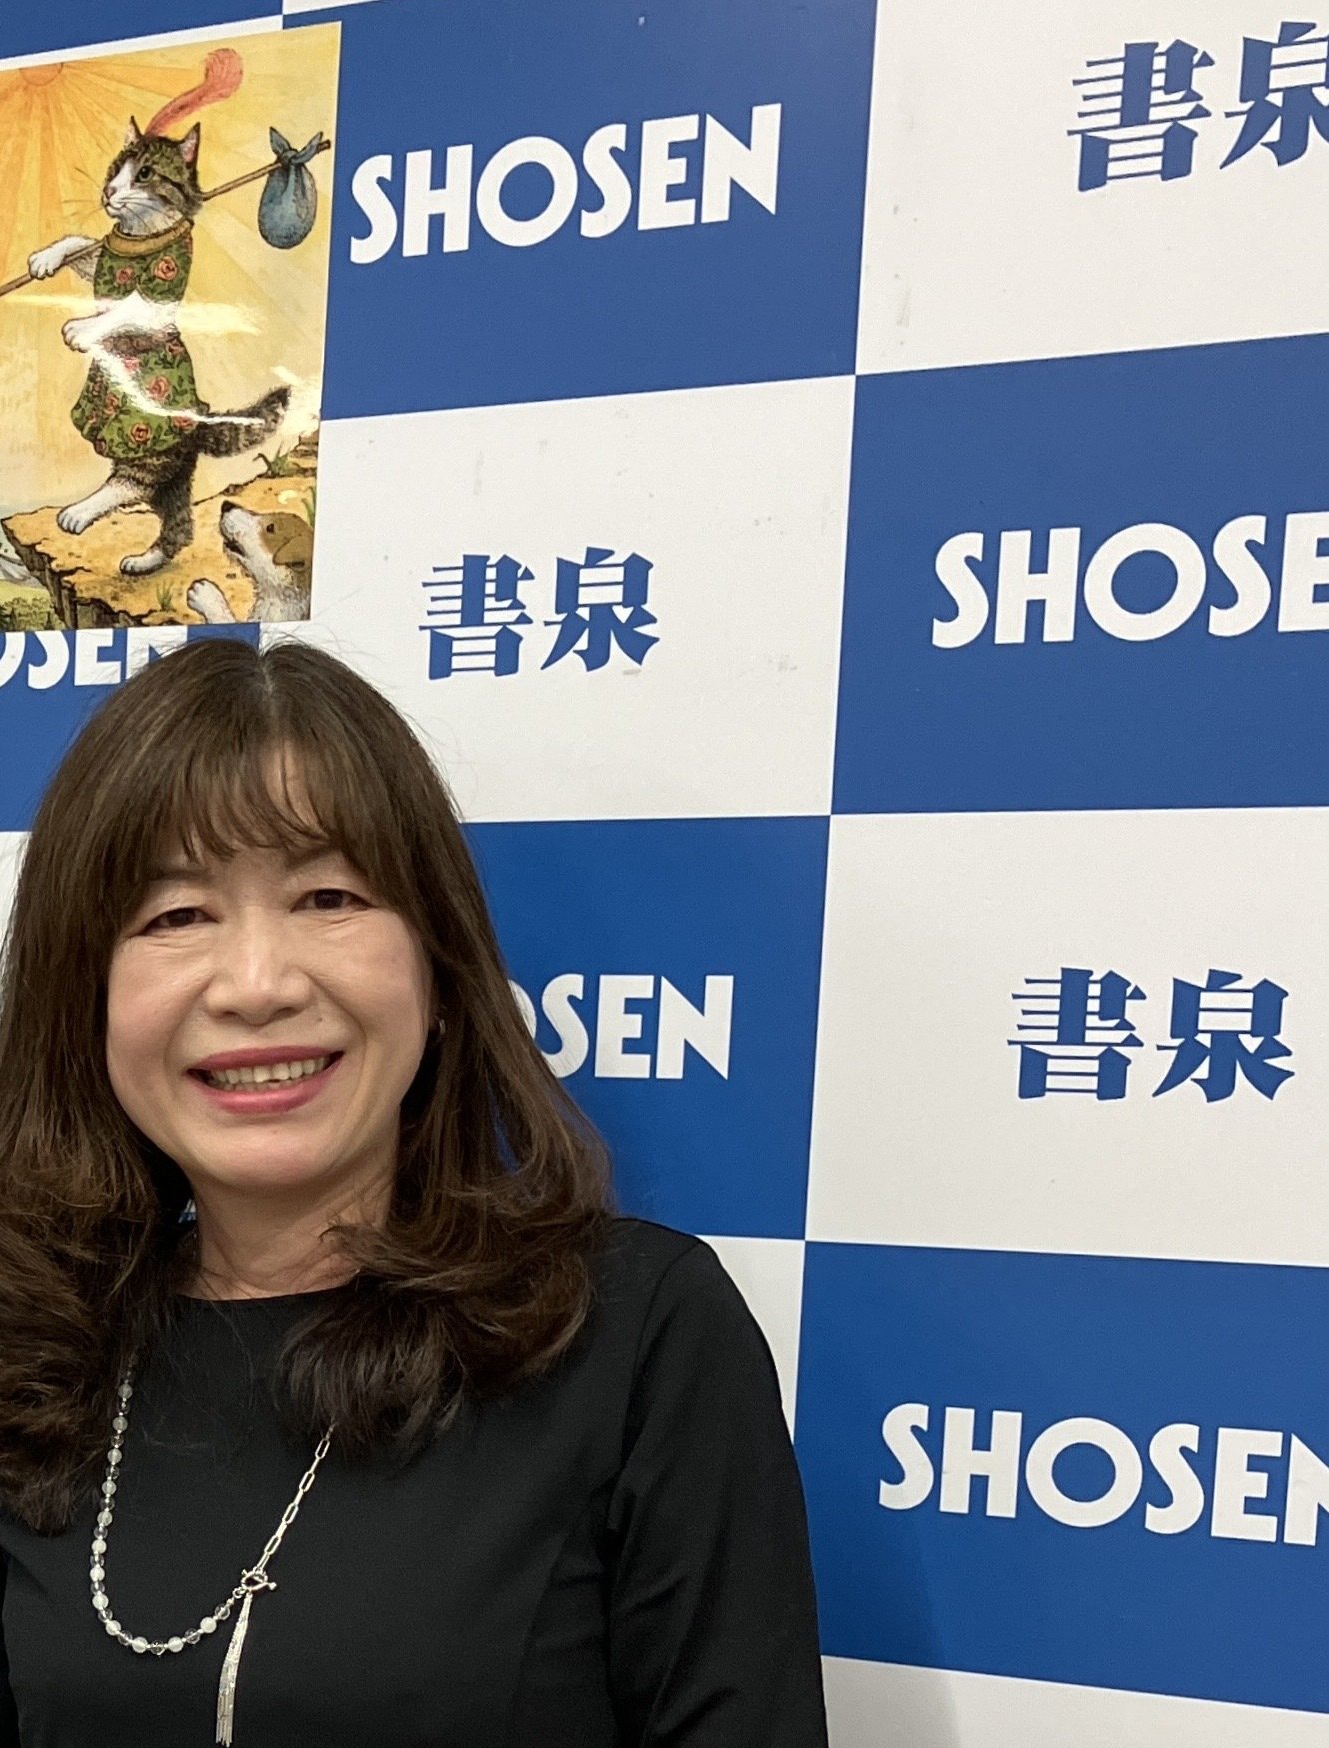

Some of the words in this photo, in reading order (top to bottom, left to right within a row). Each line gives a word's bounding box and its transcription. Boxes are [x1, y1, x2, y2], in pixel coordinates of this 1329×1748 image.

[1067, 22, 1329, 192] 書泉
[351, 103, 781, 263] SHOSEN
[413, 546, 660, 682] 書泉
[508, 974, 734, 1080] SEN
[1000, 967, 1296, 1104] 書泉
